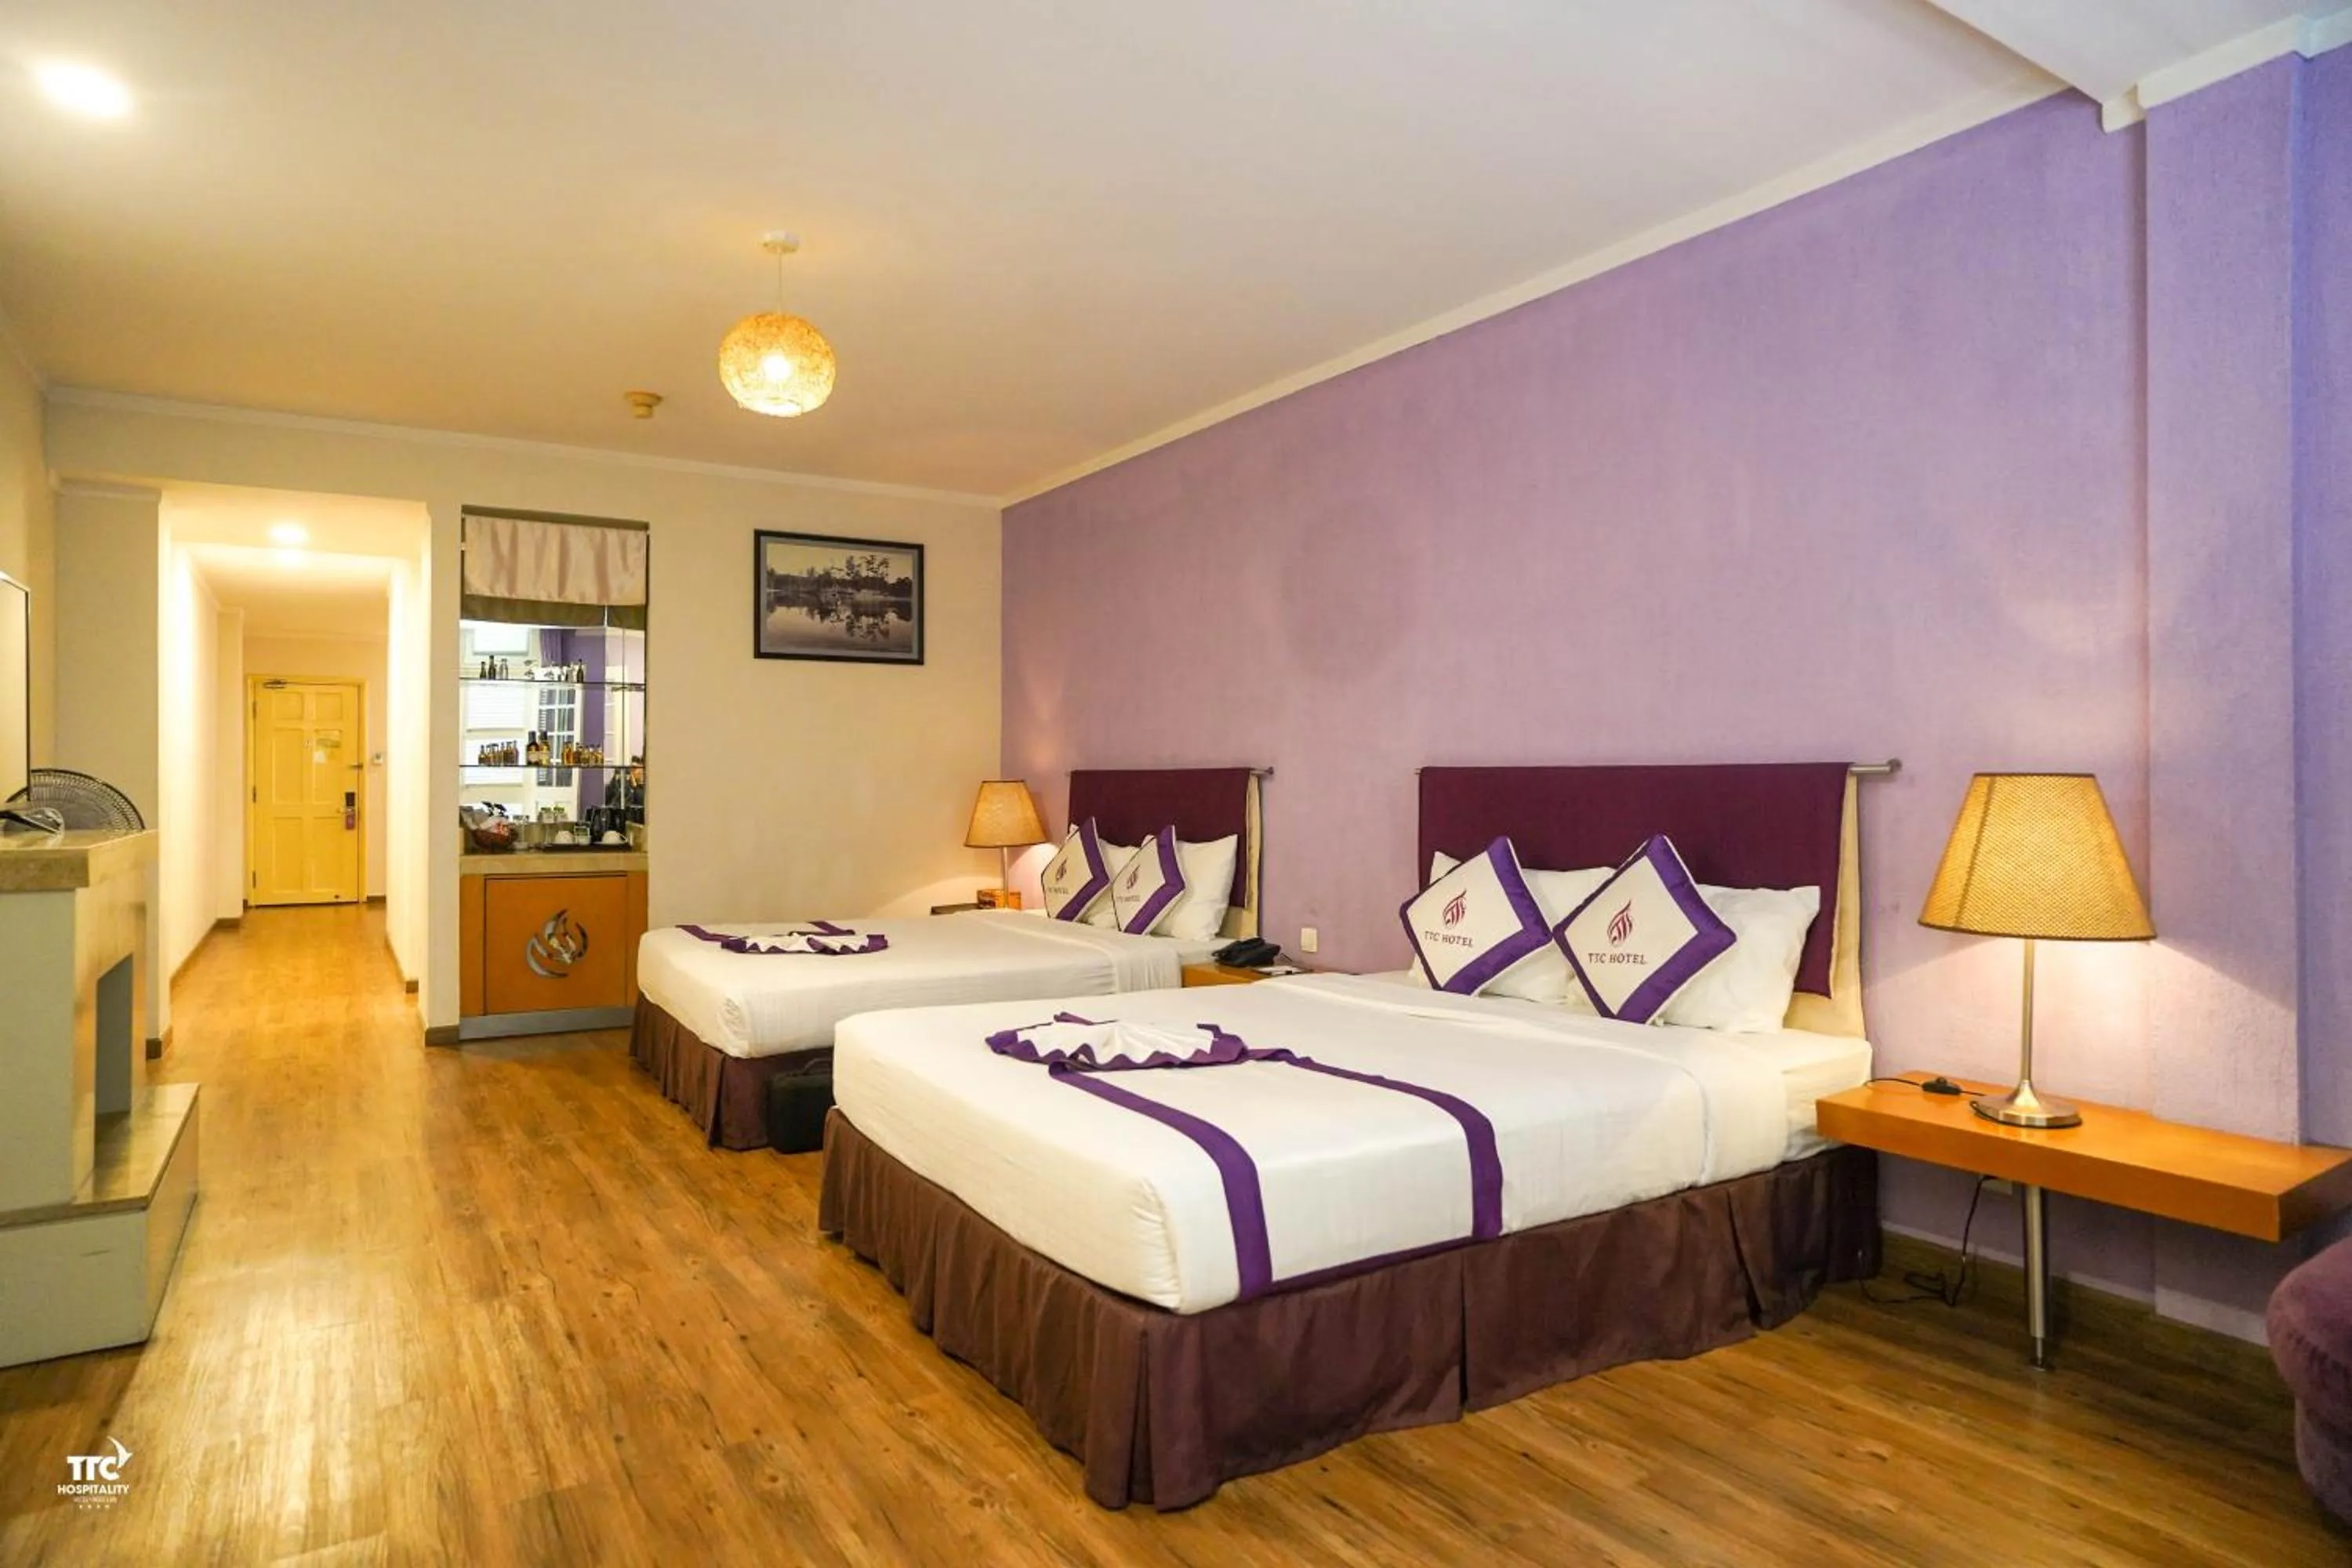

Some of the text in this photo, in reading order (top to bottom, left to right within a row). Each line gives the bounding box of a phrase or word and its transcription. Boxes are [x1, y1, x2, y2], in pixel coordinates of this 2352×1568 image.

[1425, 931, 1473, 947] TTC HOTEL
[1588, 953, 1647, 965] TTC HOTEL
